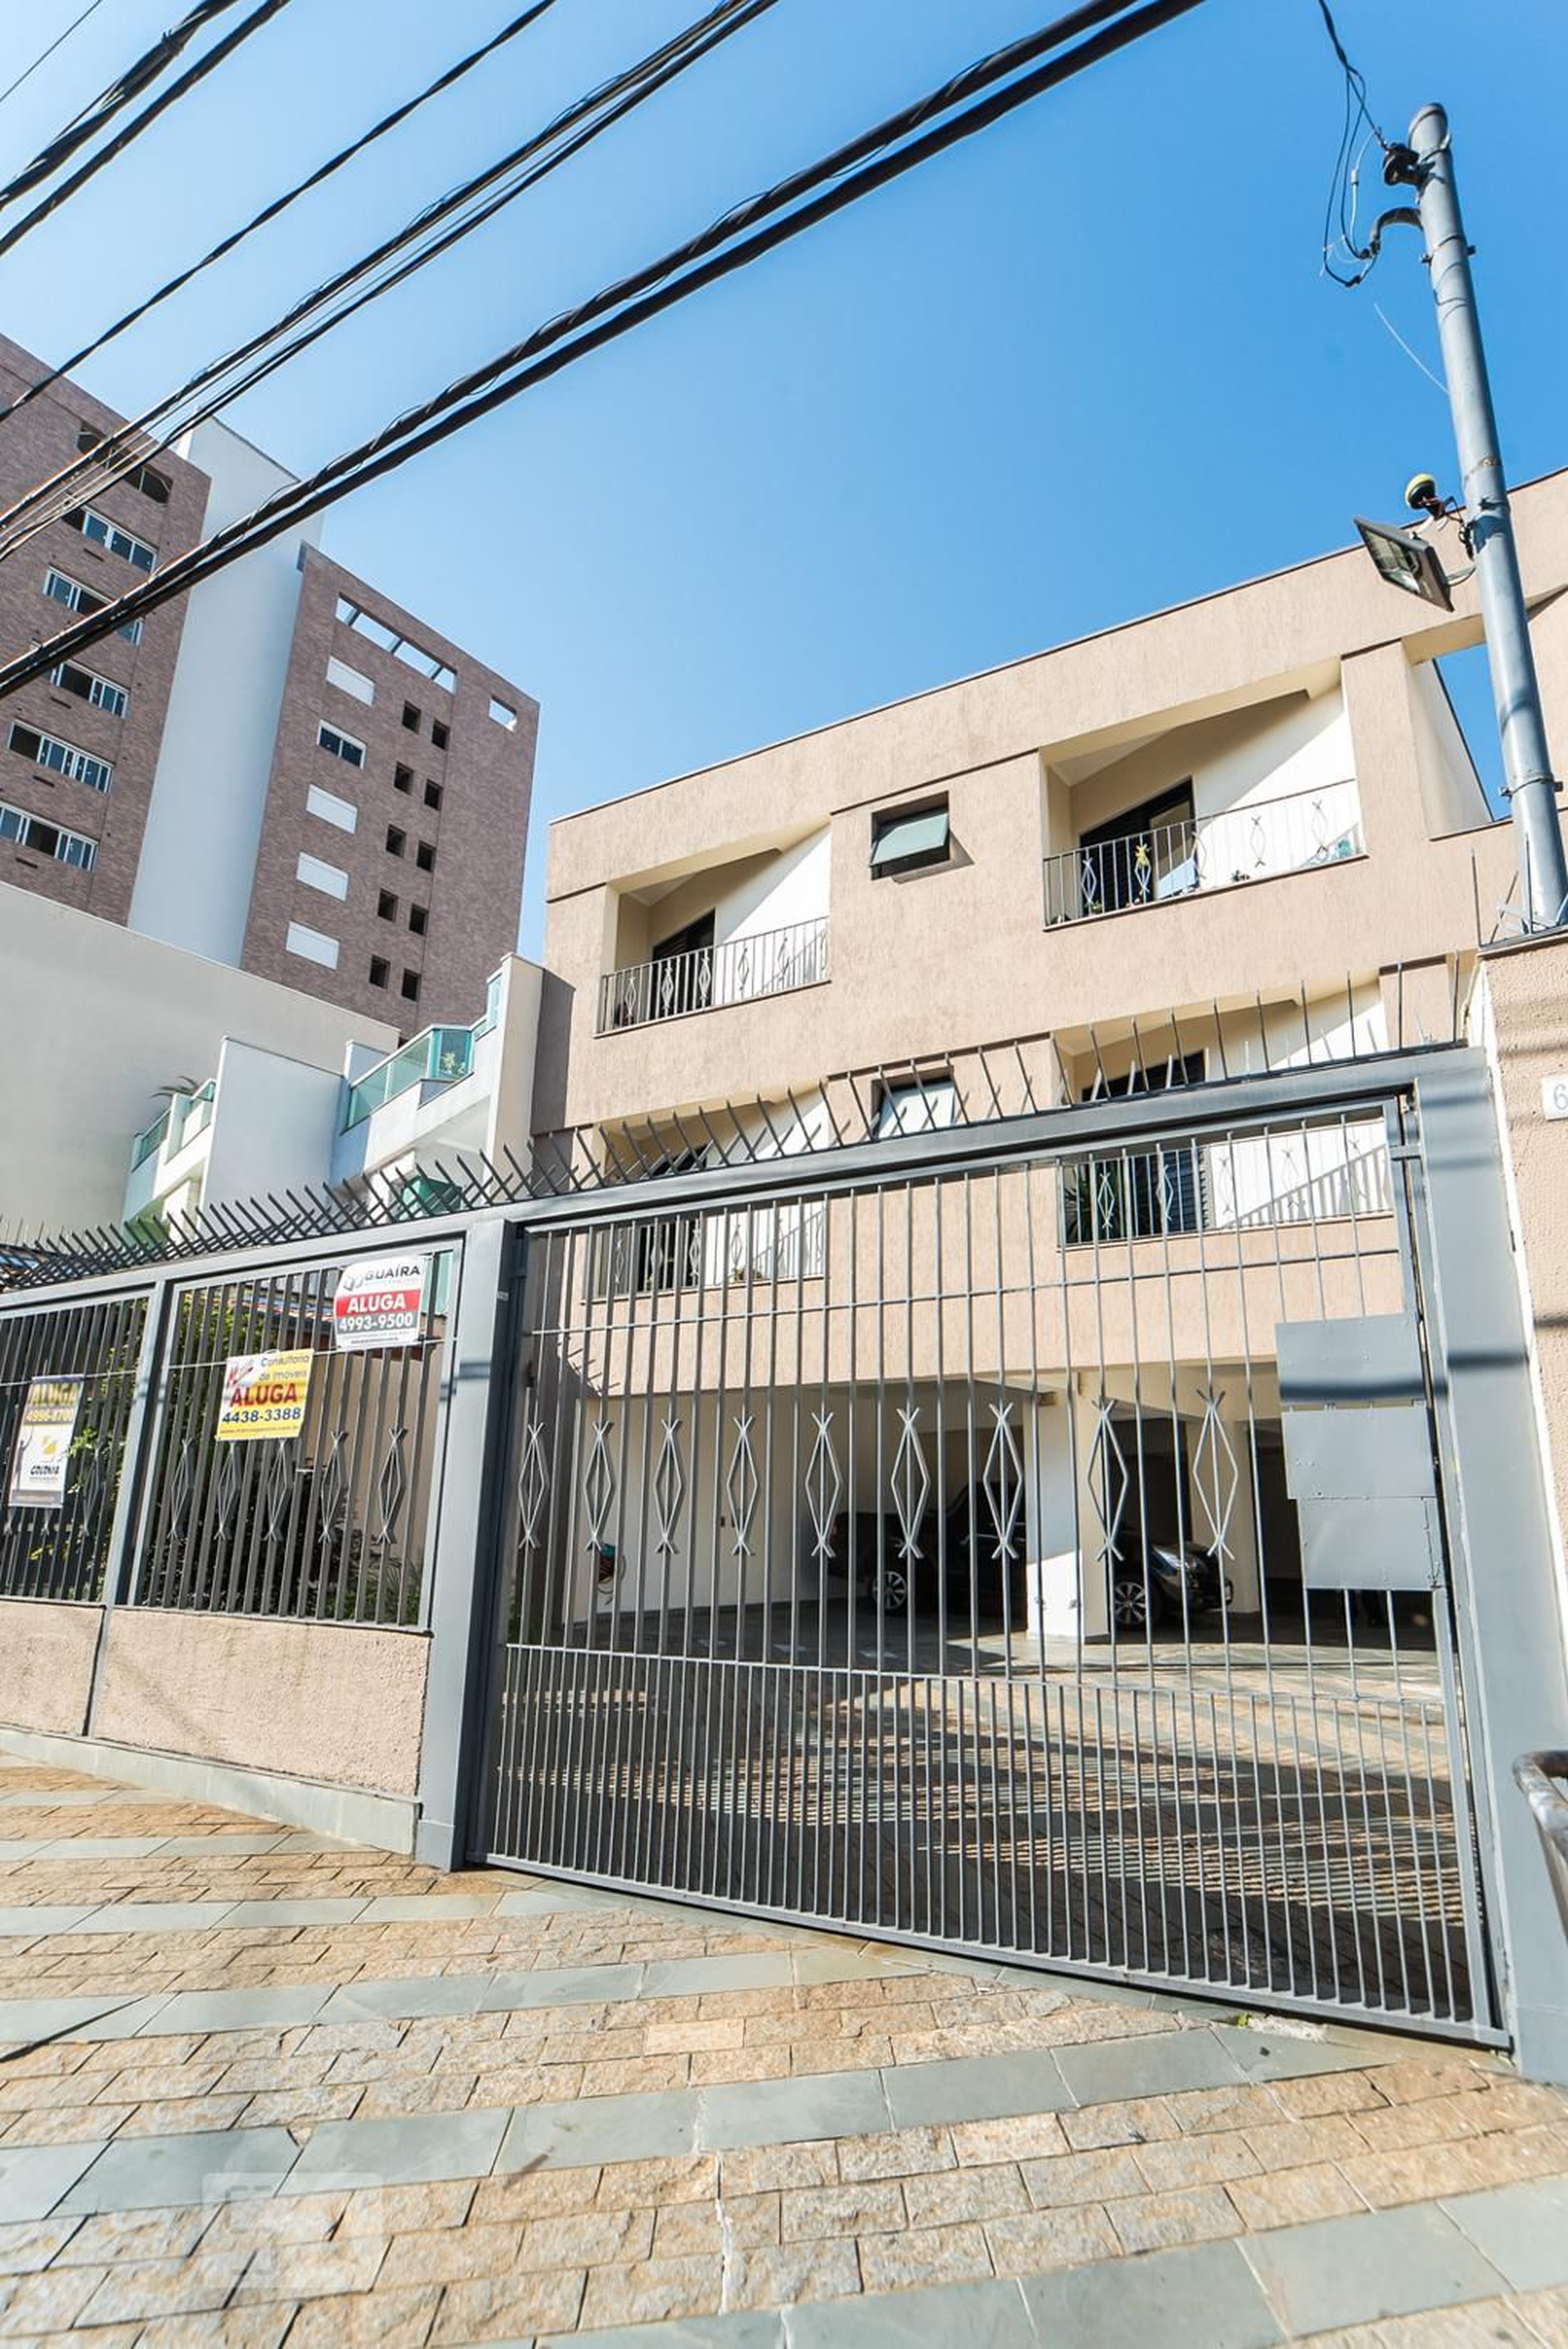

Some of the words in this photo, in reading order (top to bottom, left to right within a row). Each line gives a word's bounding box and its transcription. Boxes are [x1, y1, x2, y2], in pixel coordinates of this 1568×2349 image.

[347, 1292, 406, 1314] ALUGA
[339, 1312, 413, 1332] 4993-9500
[28, 1382, 78, 1406] ALUGA
[230, 1382, 298, 1407] ALUGA
[222, 1407, 301, 1423] 4438-3388
